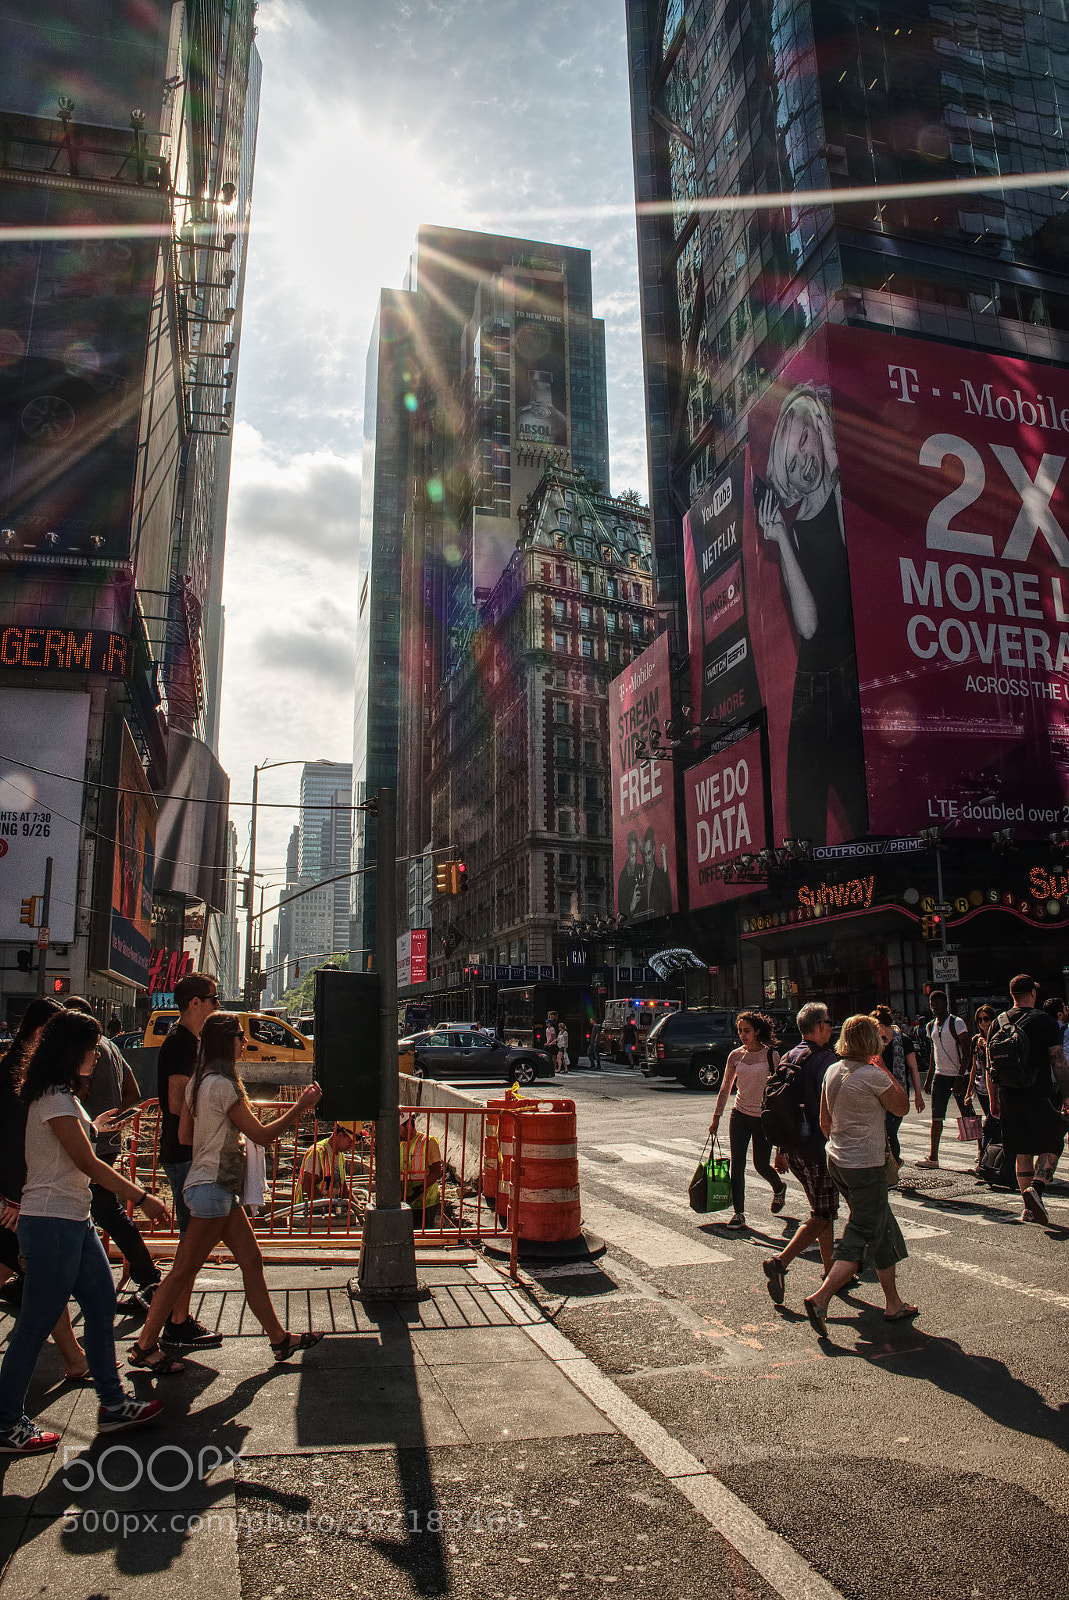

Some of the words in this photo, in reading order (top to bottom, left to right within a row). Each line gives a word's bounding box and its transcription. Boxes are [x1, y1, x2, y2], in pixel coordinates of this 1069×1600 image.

[516, 310, 525, 318] TO
[525, 312, 542, 321] NEW
[542, 314, 562, 323] YORK
[701, 477, 733, 525] YouTube
[918, 433, 1069, 569] 2X
[702, 521, 737, 574] NETFLIX
[899, 557, 1044, 621] MORE
[0, 627, 93, 669] GERM
[707, 657, 727, 680] WATCH
[727, 643, 746, 664] ESPN
[907, 614, 1069, 672] COVERA
[719, 688, 745, 720] MORE
[965, 675, 1030, 698] ACROSS
[1031, 681, 1063, 701] THE
[618, 686, 659, 740] STREAM
[619, 756, 663, 816] FREE
[695, 772, 721, 816] WE
[723, 758, 749, 804] DO
[20, 812, 31, 822] AT
[33, 812, 51, 823] 7:30
[927, 798, 958, 819] LTE
[962, 800, 1025, 821] doubled
[1028, 809, 1060, 823] over
[22, 823, 51, 837] 9/26
[696, 801, 752, 864] DATA
[816, 843, 882, 859] OUTFRONT
[798, 874, 875, 908] Subway
[1029, 866, 1069, 900] Su
[925, 899, 933, 910] N
[959, 900, 966, 910] R
[990, 891, 998, 901] S
[1006, 895, 1012, 904] 1
[1021, 902, 1028, 912] 2
[1037, 906, 1043, 917] 3
[148, 948, 189, 996] H&M
[572, 950, 587, 964] GAP
